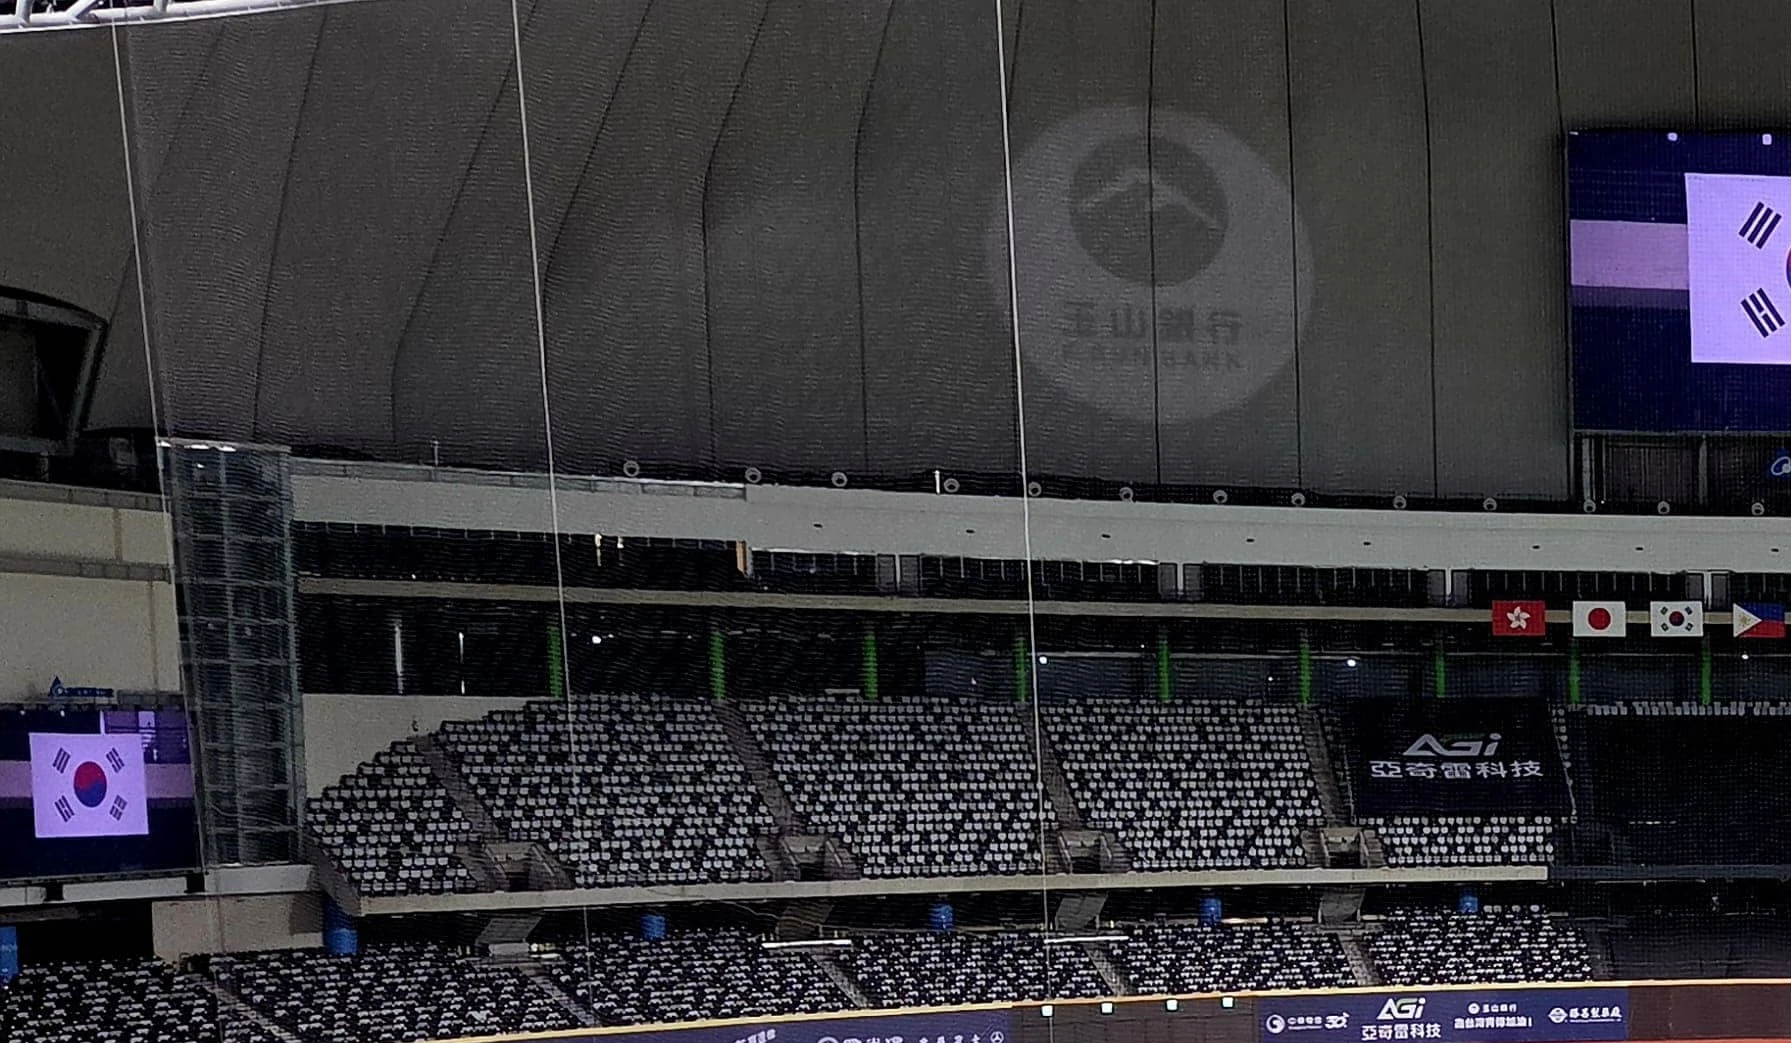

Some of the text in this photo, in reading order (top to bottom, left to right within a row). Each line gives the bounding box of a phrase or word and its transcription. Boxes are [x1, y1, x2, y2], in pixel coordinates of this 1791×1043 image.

[1369, 760, 1543, 779] 亞奇雷科技
[1361, 1023, 1441, 1041] 亞奇雷科技
